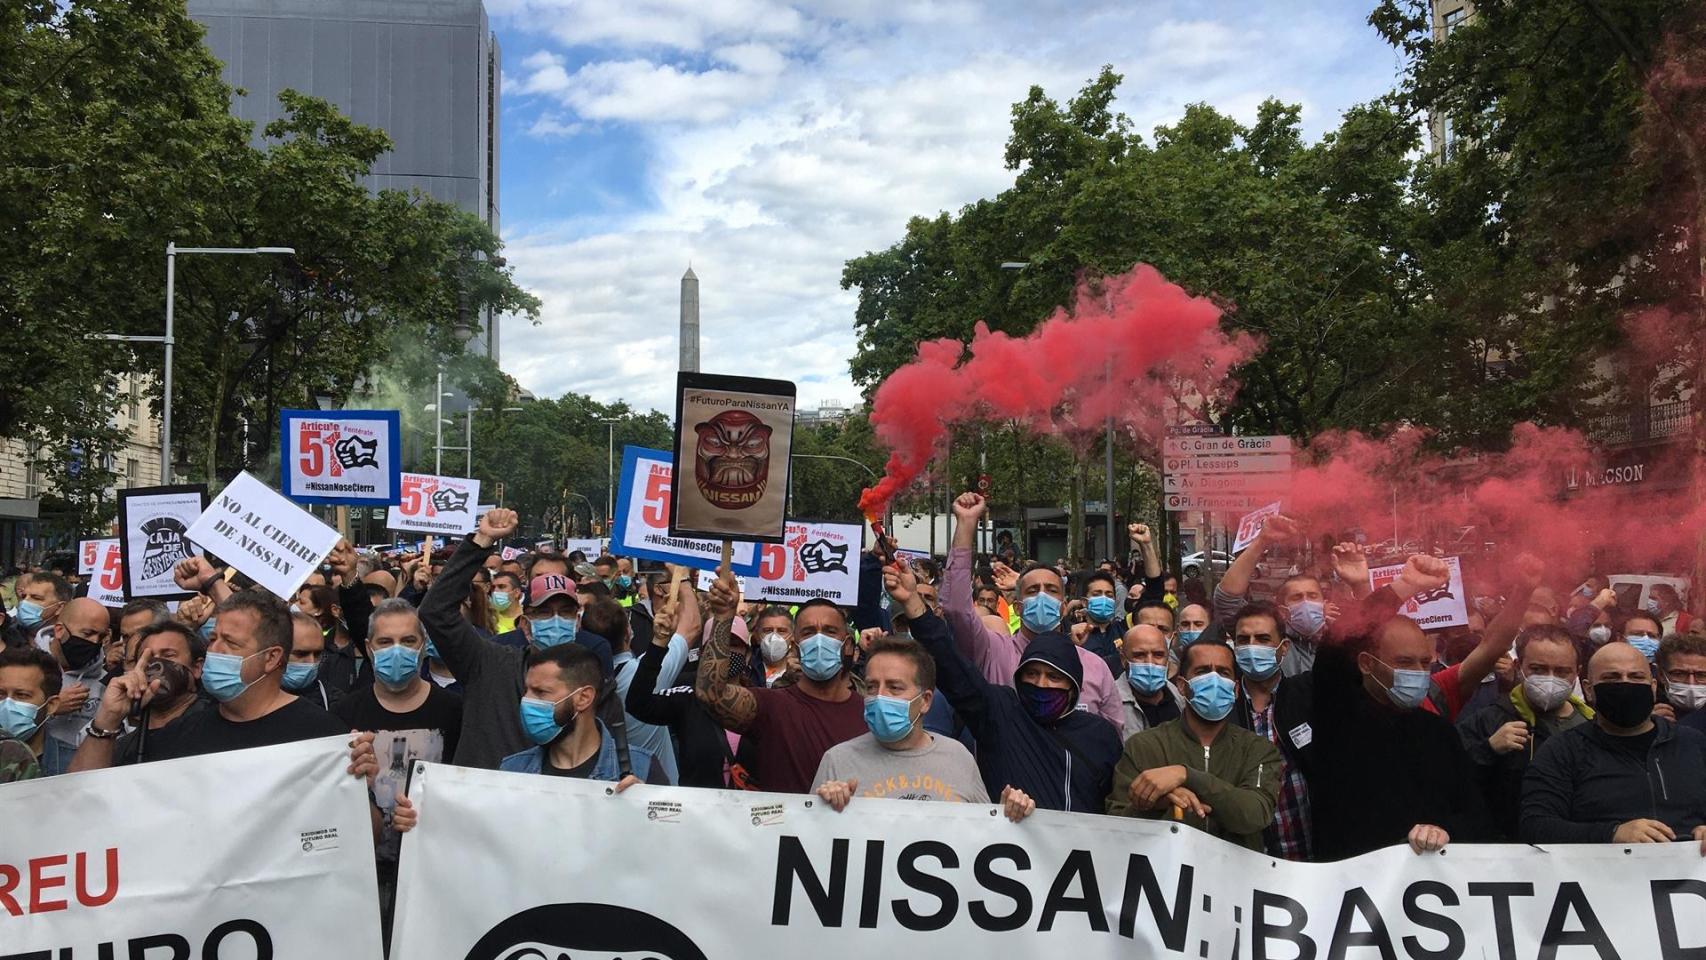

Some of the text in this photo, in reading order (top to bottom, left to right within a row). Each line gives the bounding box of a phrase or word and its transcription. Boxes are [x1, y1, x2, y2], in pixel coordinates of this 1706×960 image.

[689, 396, 789, 411] #FuturoParaNissanYA
[1194, 440, 1218, 450] Gran
[1222, 440, 1234, 449] de
[1237, 438, 1271, 448] Gràcia
[300, 431, 341, 476] 51
[1196, 459, 1239, 469] Lesseps
[305, 482, 375, 493] #NissanNoseCierra
[702, 487, 760, 503] NISSAN
[399, 481, 437, 517] 51
[149, 531, 180, 544] CAJA
[217, 495, 321, 566] NO AL CIERRE
[163, 543, 182, 552] DE
[213, 519, 295, 577] DE NISSAN
[644, 534, 735, 557] #NissanNoseCiea
[761, 586, 842, 599] #NissanNoseCierra
